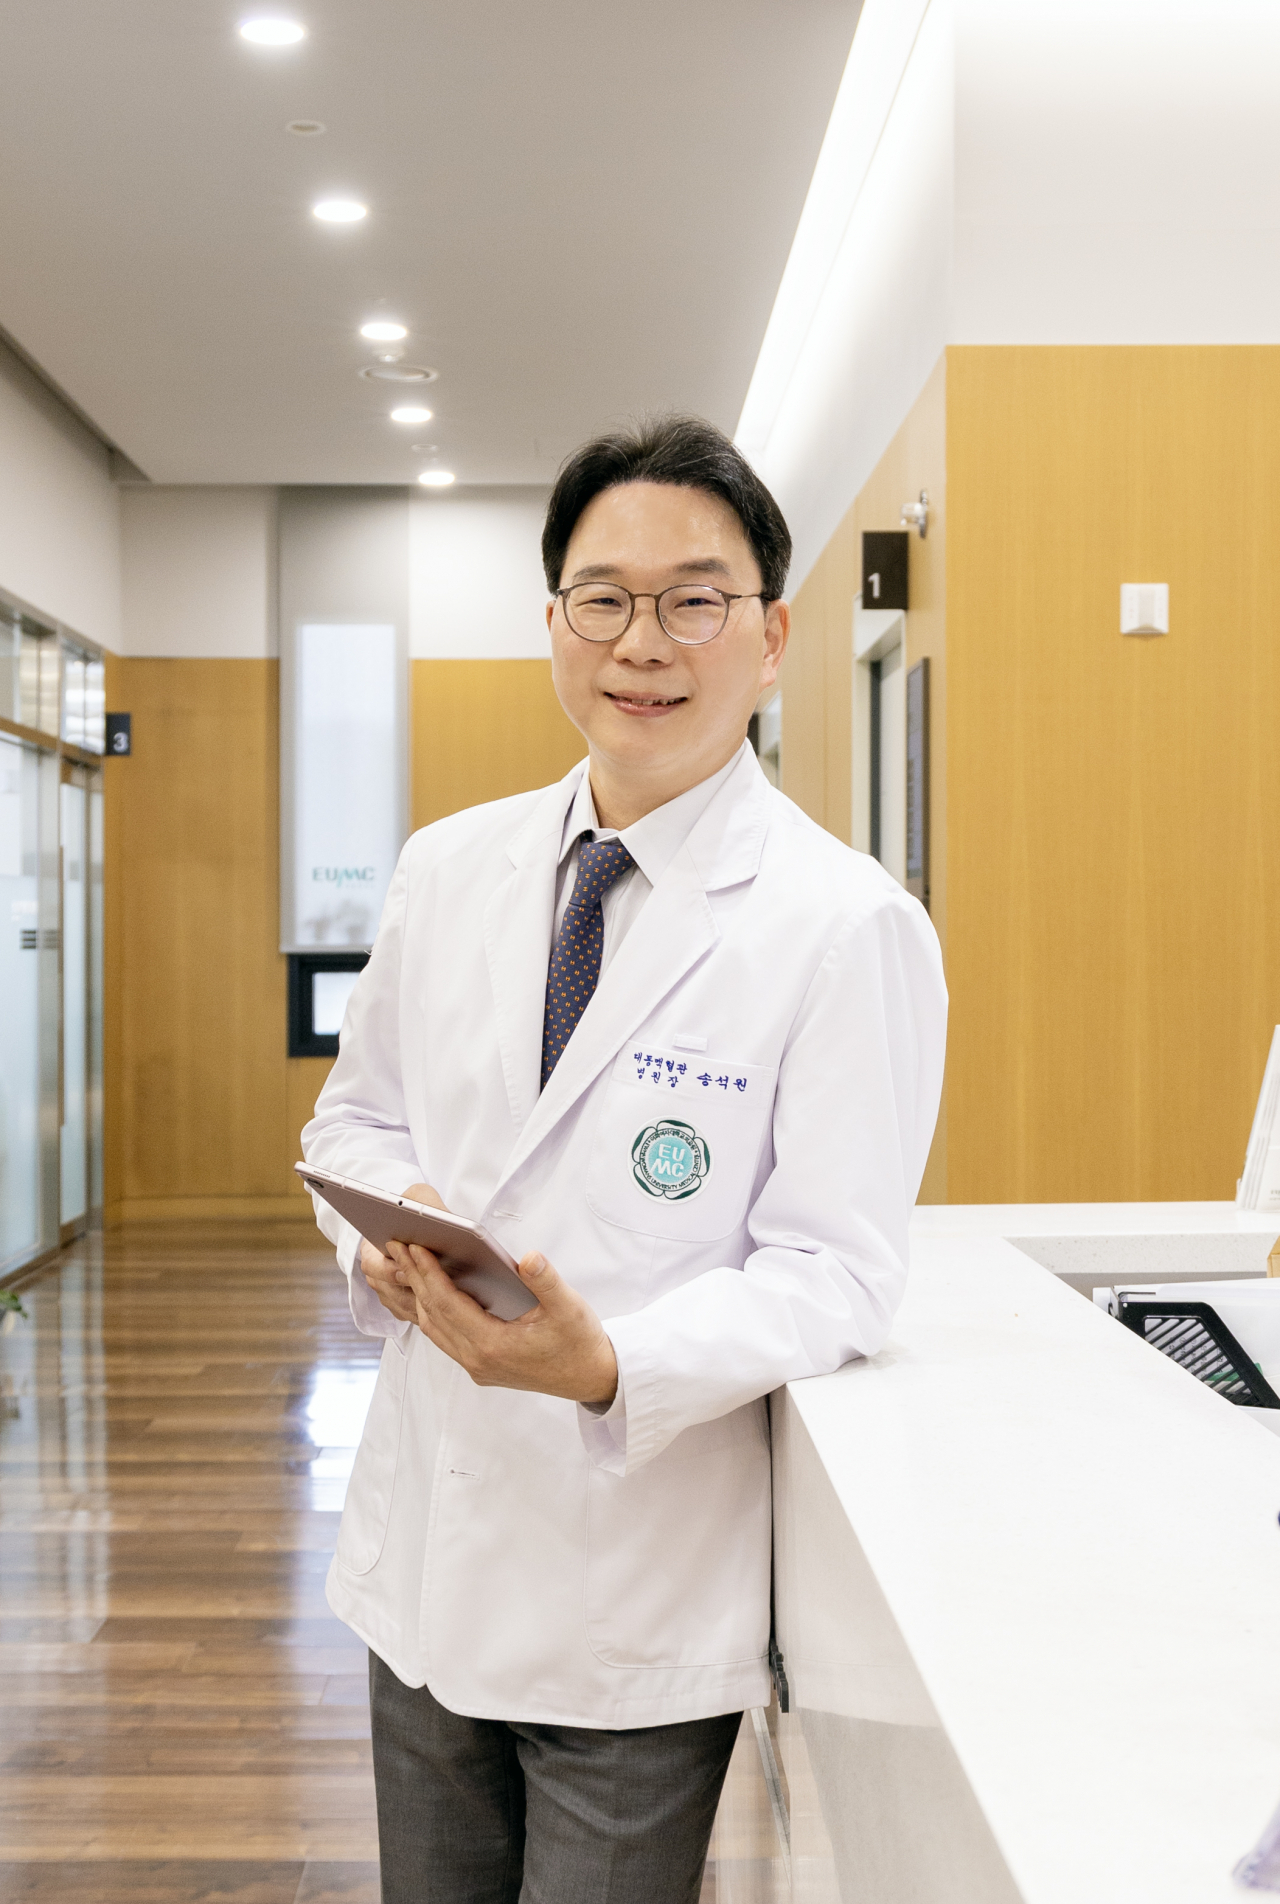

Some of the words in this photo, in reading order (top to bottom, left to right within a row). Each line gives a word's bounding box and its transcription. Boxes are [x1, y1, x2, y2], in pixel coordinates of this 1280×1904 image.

[868, 572, 880, 598] 1
[113, 732, 128, 752] 3
[312, 866, 375, 888] EUMC
[696, 1072, 747, 1092] 송석원
